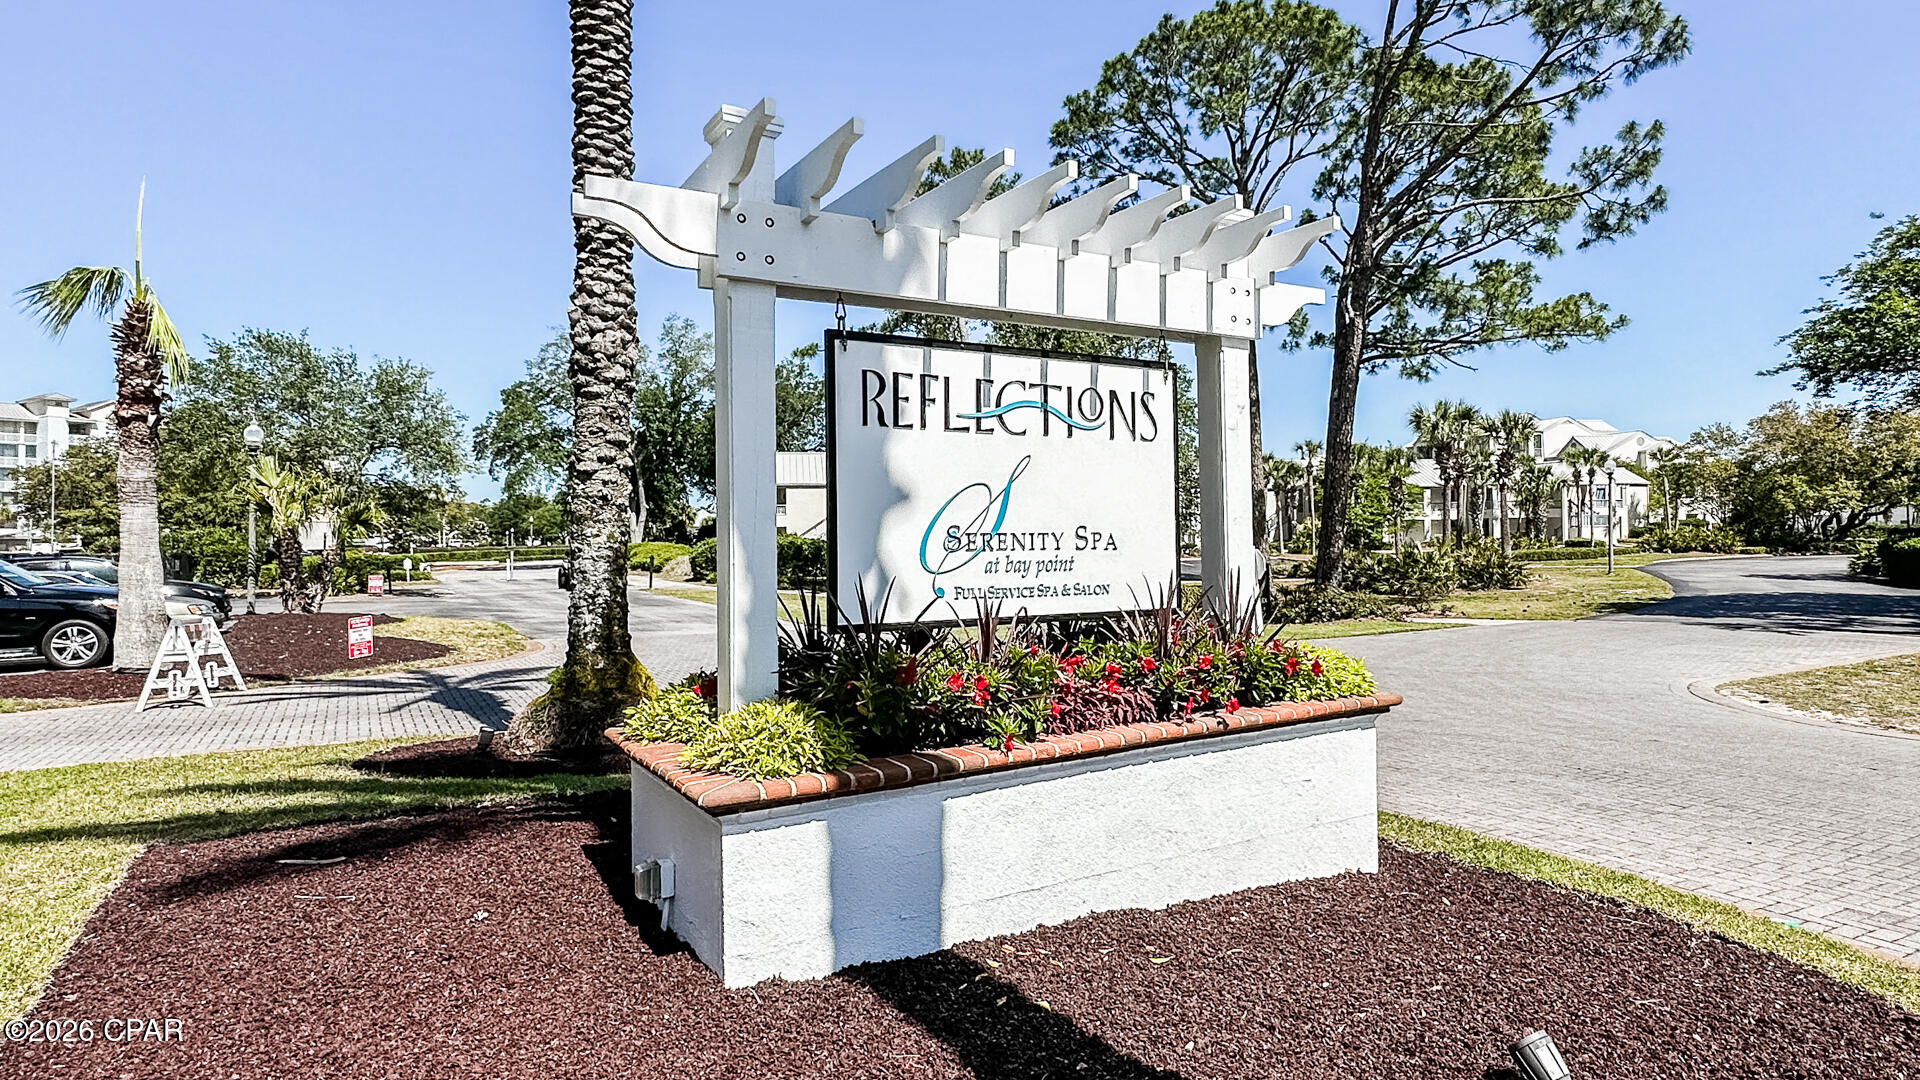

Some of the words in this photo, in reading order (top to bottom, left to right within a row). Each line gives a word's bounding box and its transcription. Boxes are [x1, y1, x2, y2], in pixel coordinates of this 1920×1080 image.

[861, 369, 1158, 442] REFLECTIONS
[946, 525, 1064, 552] SERENITY
[1075, 525, 1118, 551] SPA
[984, 557, 1000, 574] at
[1005, 555, 1032, 578] bay
[1035, 554, 1075, 578] point
[954, 586, 985, 600] FULL
[987, 585, 1035, 600] SERVICE
[1037, 583, 1059, 598] SPA
[1061, 584, 1071, 596] &
[1073, 582, 1110, 597] SALON
